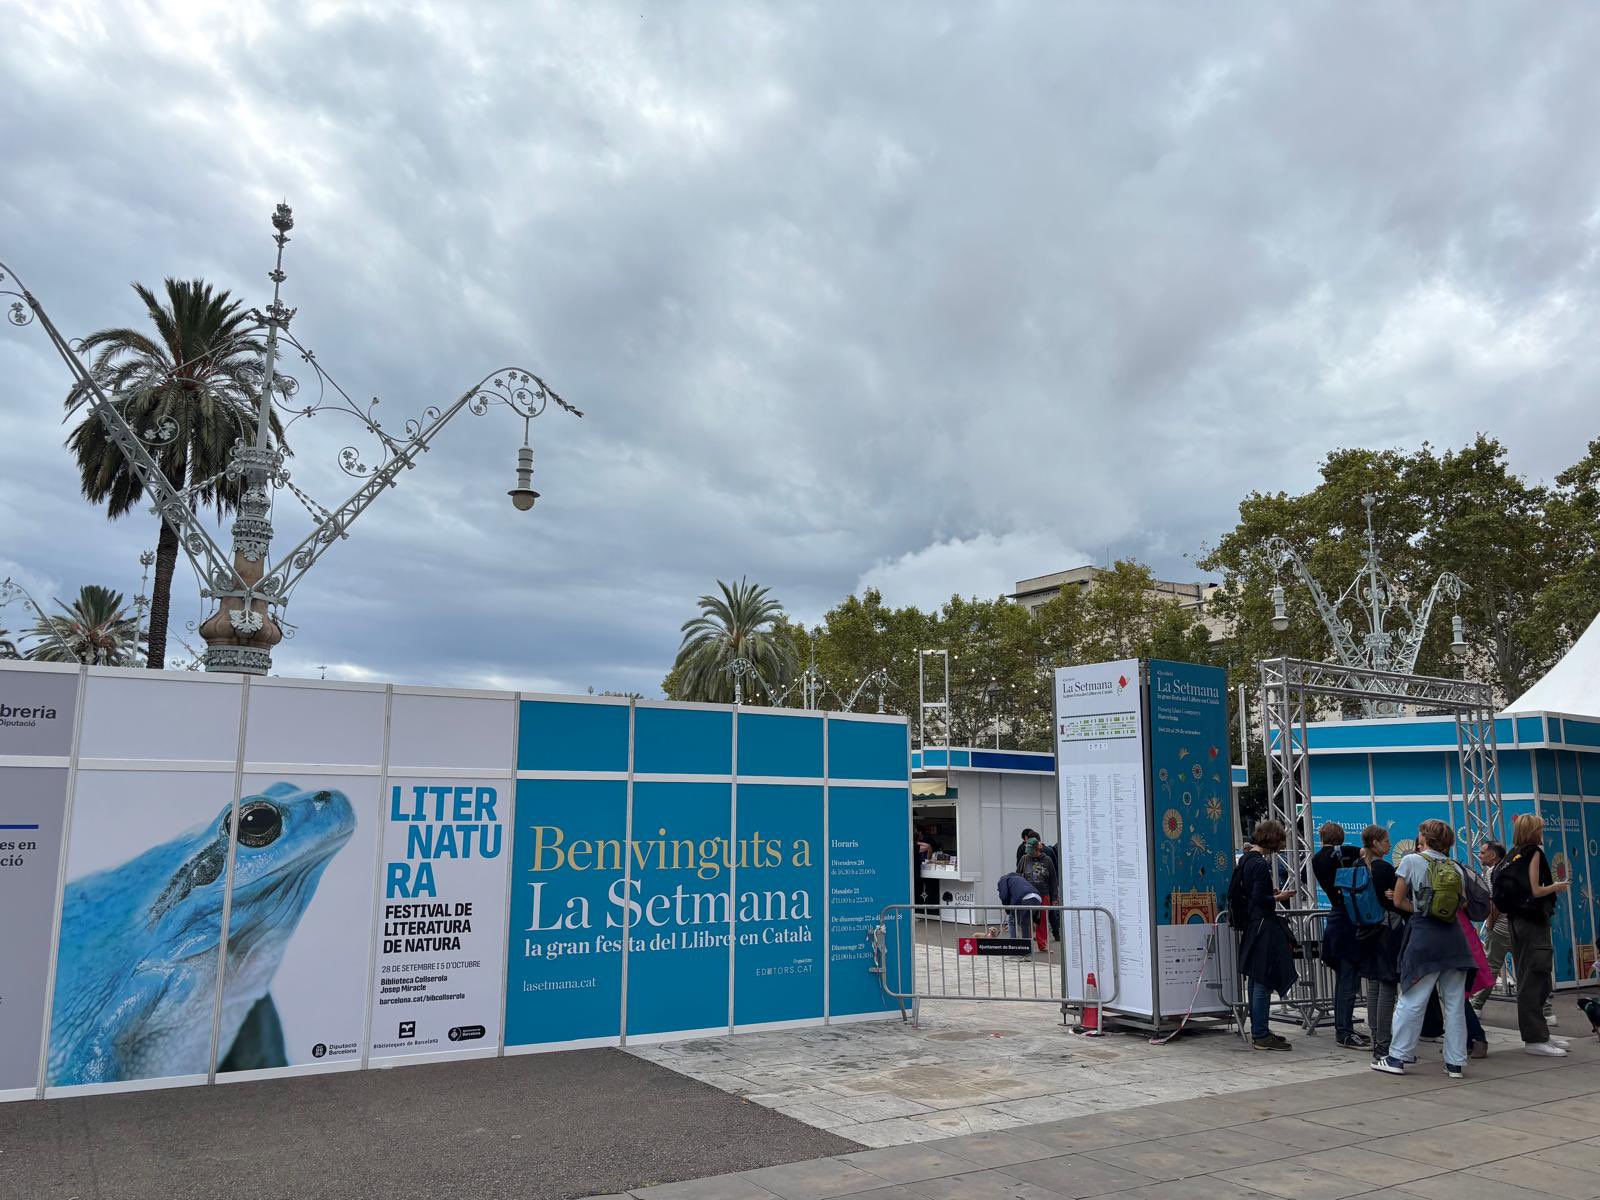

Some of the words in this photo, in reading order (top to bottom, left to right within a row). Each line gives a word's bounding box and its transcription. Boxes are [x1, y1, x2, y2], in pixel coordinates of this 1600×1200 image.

[1063, 683, 1073, 694] La
[1074, 681, 1113, 693] Setmana
[1157, 677, 1171, 693] La
[1173, 679, 1219, 698] Setmana
[391, 786, 498, 822] LITER
[18, 841, 37, 850] en
[406, 824, 503, 860] NATU
[831, 839, 859, 848] Horaris
[527, 825, 783, 880] Benvinguts
[792, 839, 813, 868] a
[386, 862, 437, 899] RA
[524, 882, 593, 931] La
[606, 878, 813, 929] Setmana
[954, 892, 974, 902] Godall
[385, 903, 452, 919] FESTIVAL
[454, 903, 473, 917] DE
[384, 919, 472, 937] LITERATURA
[383, 939, 402, 954] DE
[404, 936, 461, 953] NATURA
[524, 938, 542, 957] la
[546, 939, 590, 961] gran
[595, 934, 646, 953] festa
[649, 932, 676, 951] del
[681, 930, 737, 950] Llibre
[739, 932, 759, 946] en
[762, 925, 812, 945] Català
[381, 965, 391, 973] 28
[392, 964, 401, 973] DE
[402, 962, 436, 972] SETEMBRE
[440, 962, 445, 970] 5
[446, 960, 481, 969] D'OCTUBRE
[380, 977, 414, 986] Biblioteca
[415, 974, 448, 984] Collserola
[522, 977, 597, 992] lasetmana.cat
[380, 985, 401, 995] Josep
[401, 984, 427, 992] Miracle
[329, 1042, 357, 1050] Diputació
[414, 1038, 439, 1046] Barcelona
[328, 1048, 357, 1056] Barcelona
